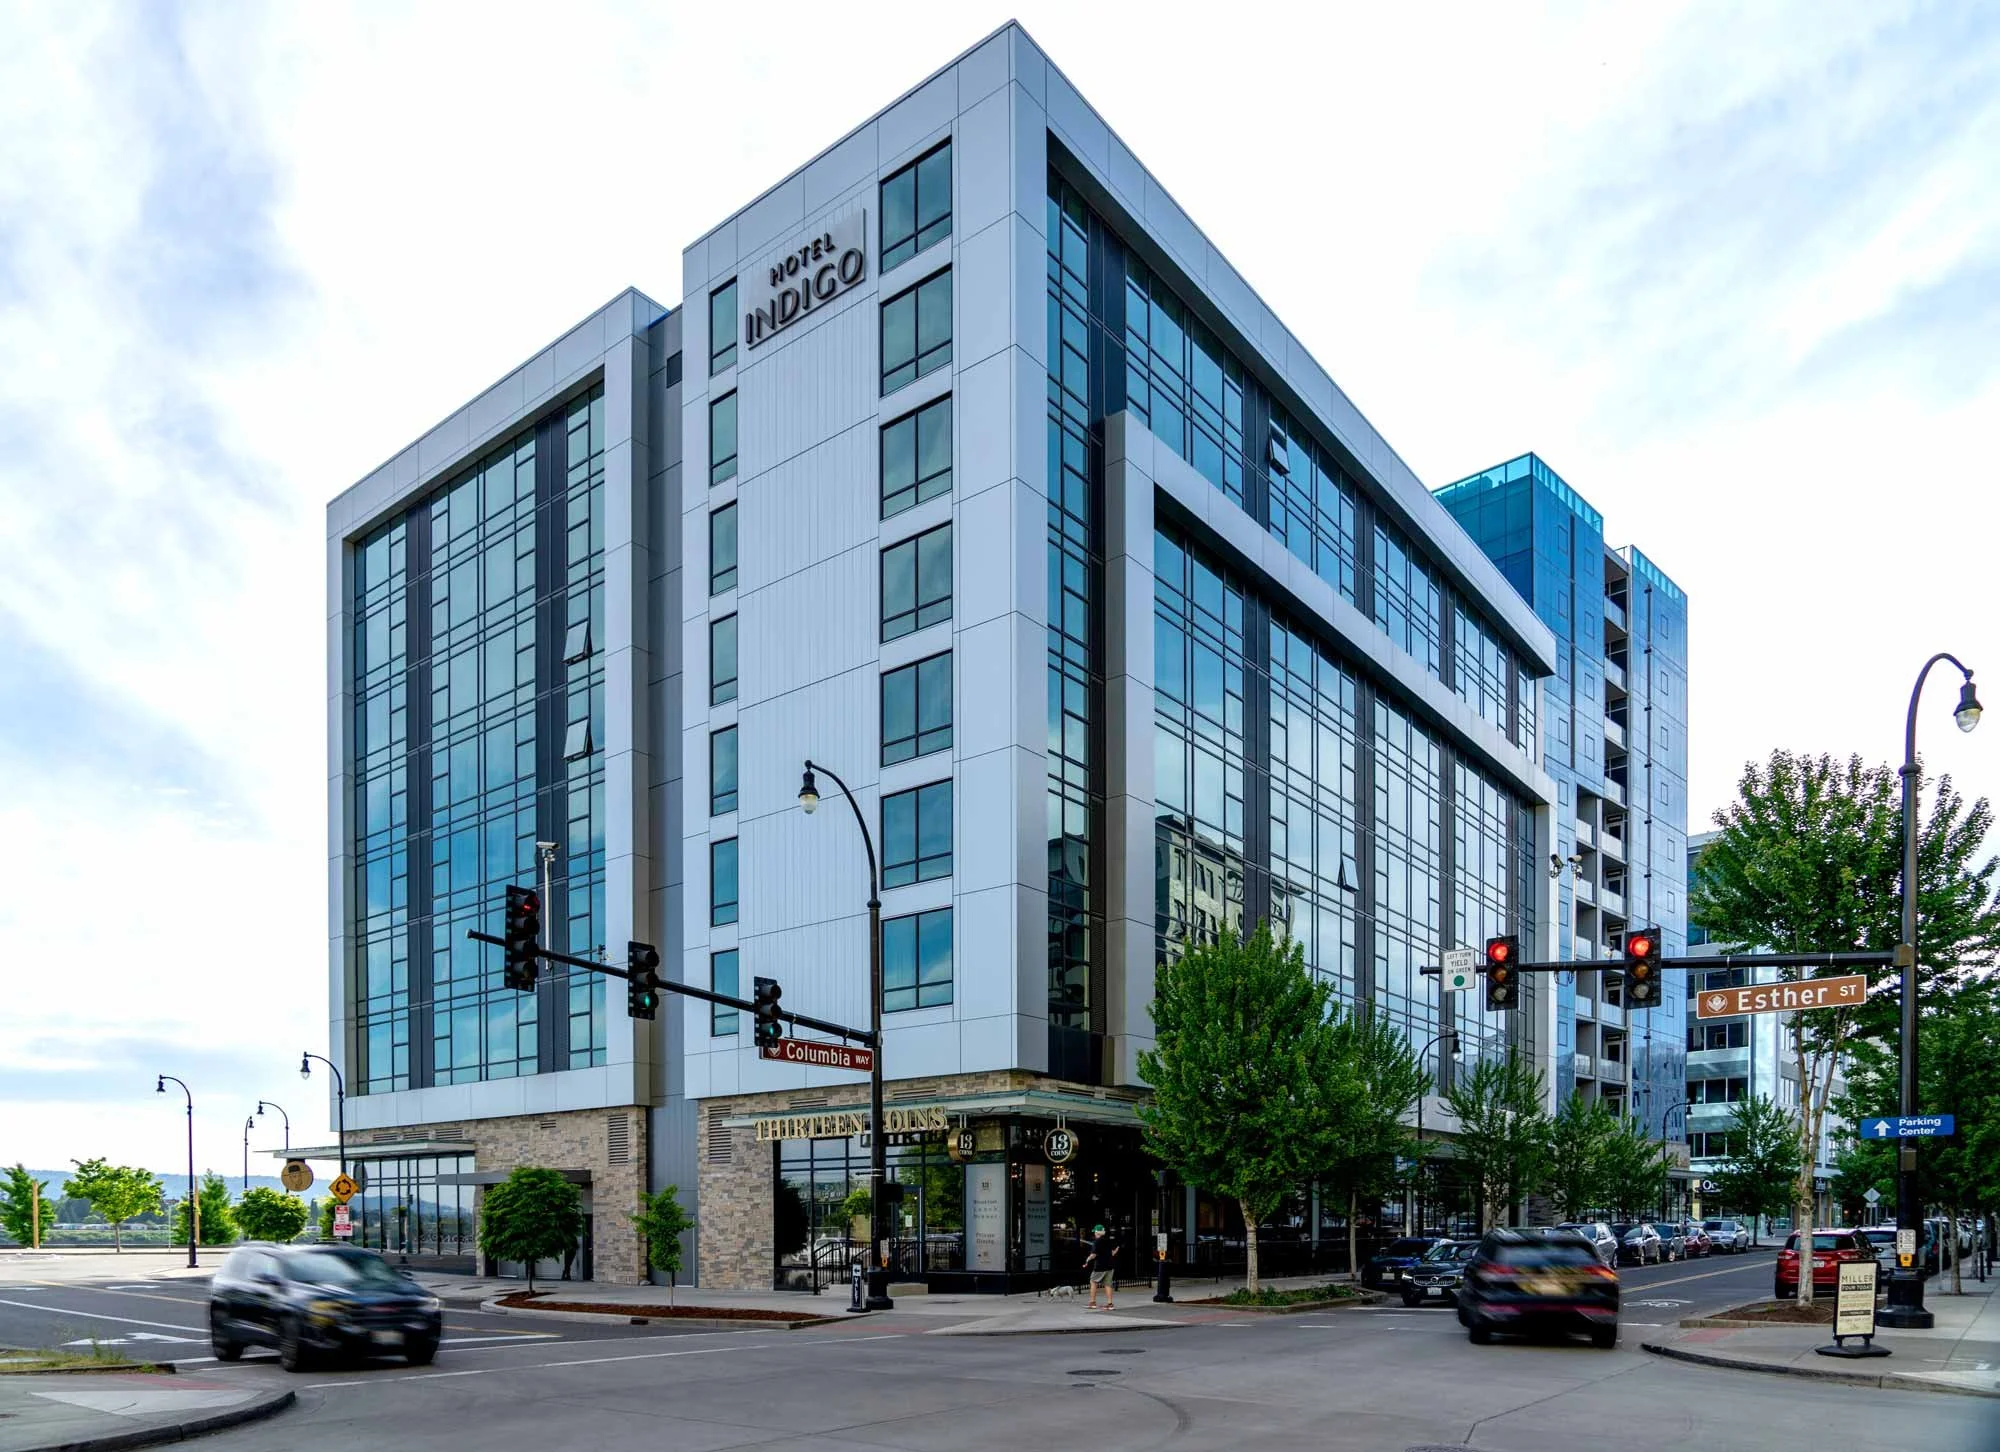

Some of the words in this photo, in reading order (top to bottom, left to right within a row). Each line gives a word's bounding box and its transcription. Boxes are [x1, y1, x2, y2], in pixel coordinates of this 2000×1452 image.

[770, 232, 835, 287] HOTEL
[745, 248, 863, 345] INDIGO
[1451, 959, 1468, 967] YIELD
[1737, 985, 1828, 1011] Esther
[1839, 984, 1857, 997] ST
[786, 1042, 851, 1066] Columbia
[855, 1054, 870, 1065] WAY
[755, 1112, 865, 1141] THIRTEEN
[882, 1105, 948, 1132] OINS
[1899, 1117, 1942, 1128] Parking
[1898, 1126, 1936, 1136] Center
[960, 1134, 973, 1149] 13
[1050, 1134, 1068, 1150] 13
[1050, 1149, 1068, 1157] COINS
[1842, 1274, 1873, 1283] MILLER
